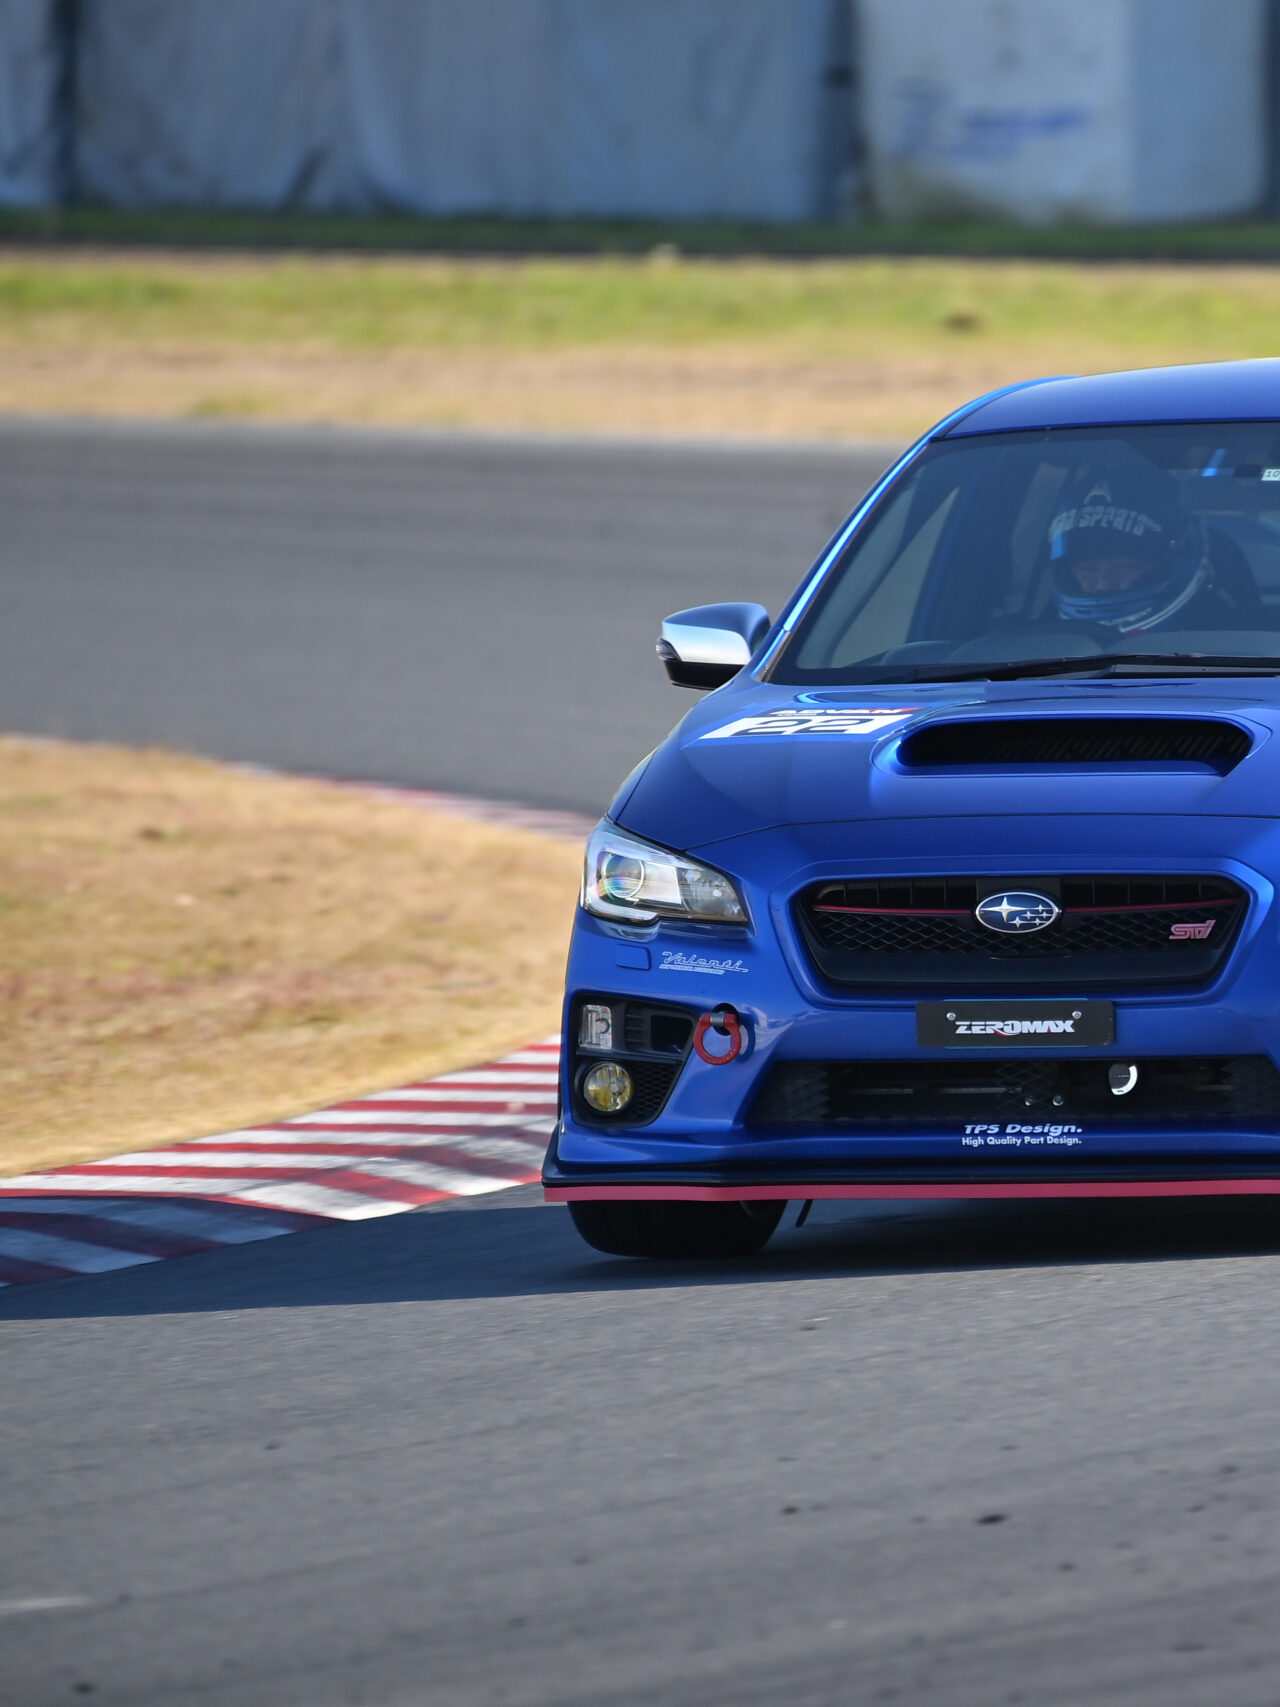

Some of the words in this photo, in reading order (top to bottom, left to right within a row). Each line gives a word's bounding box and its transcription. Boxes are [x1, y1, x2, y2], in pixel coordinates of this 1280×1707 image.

[730, 717, 874, 736] 22
[954, 1019, 1076, 1037] ZEROMAX
[963, 1124, 1000, 1135] TPS
[1005, 1123, 1083, 1136] Design.
[961, 1136, 985, 1147] High
[986, 1136, 1022, 1147] Quality
[1024, 1136, 1044, 1146] Part
[1046, 1135, 1083, 1147] Design.
